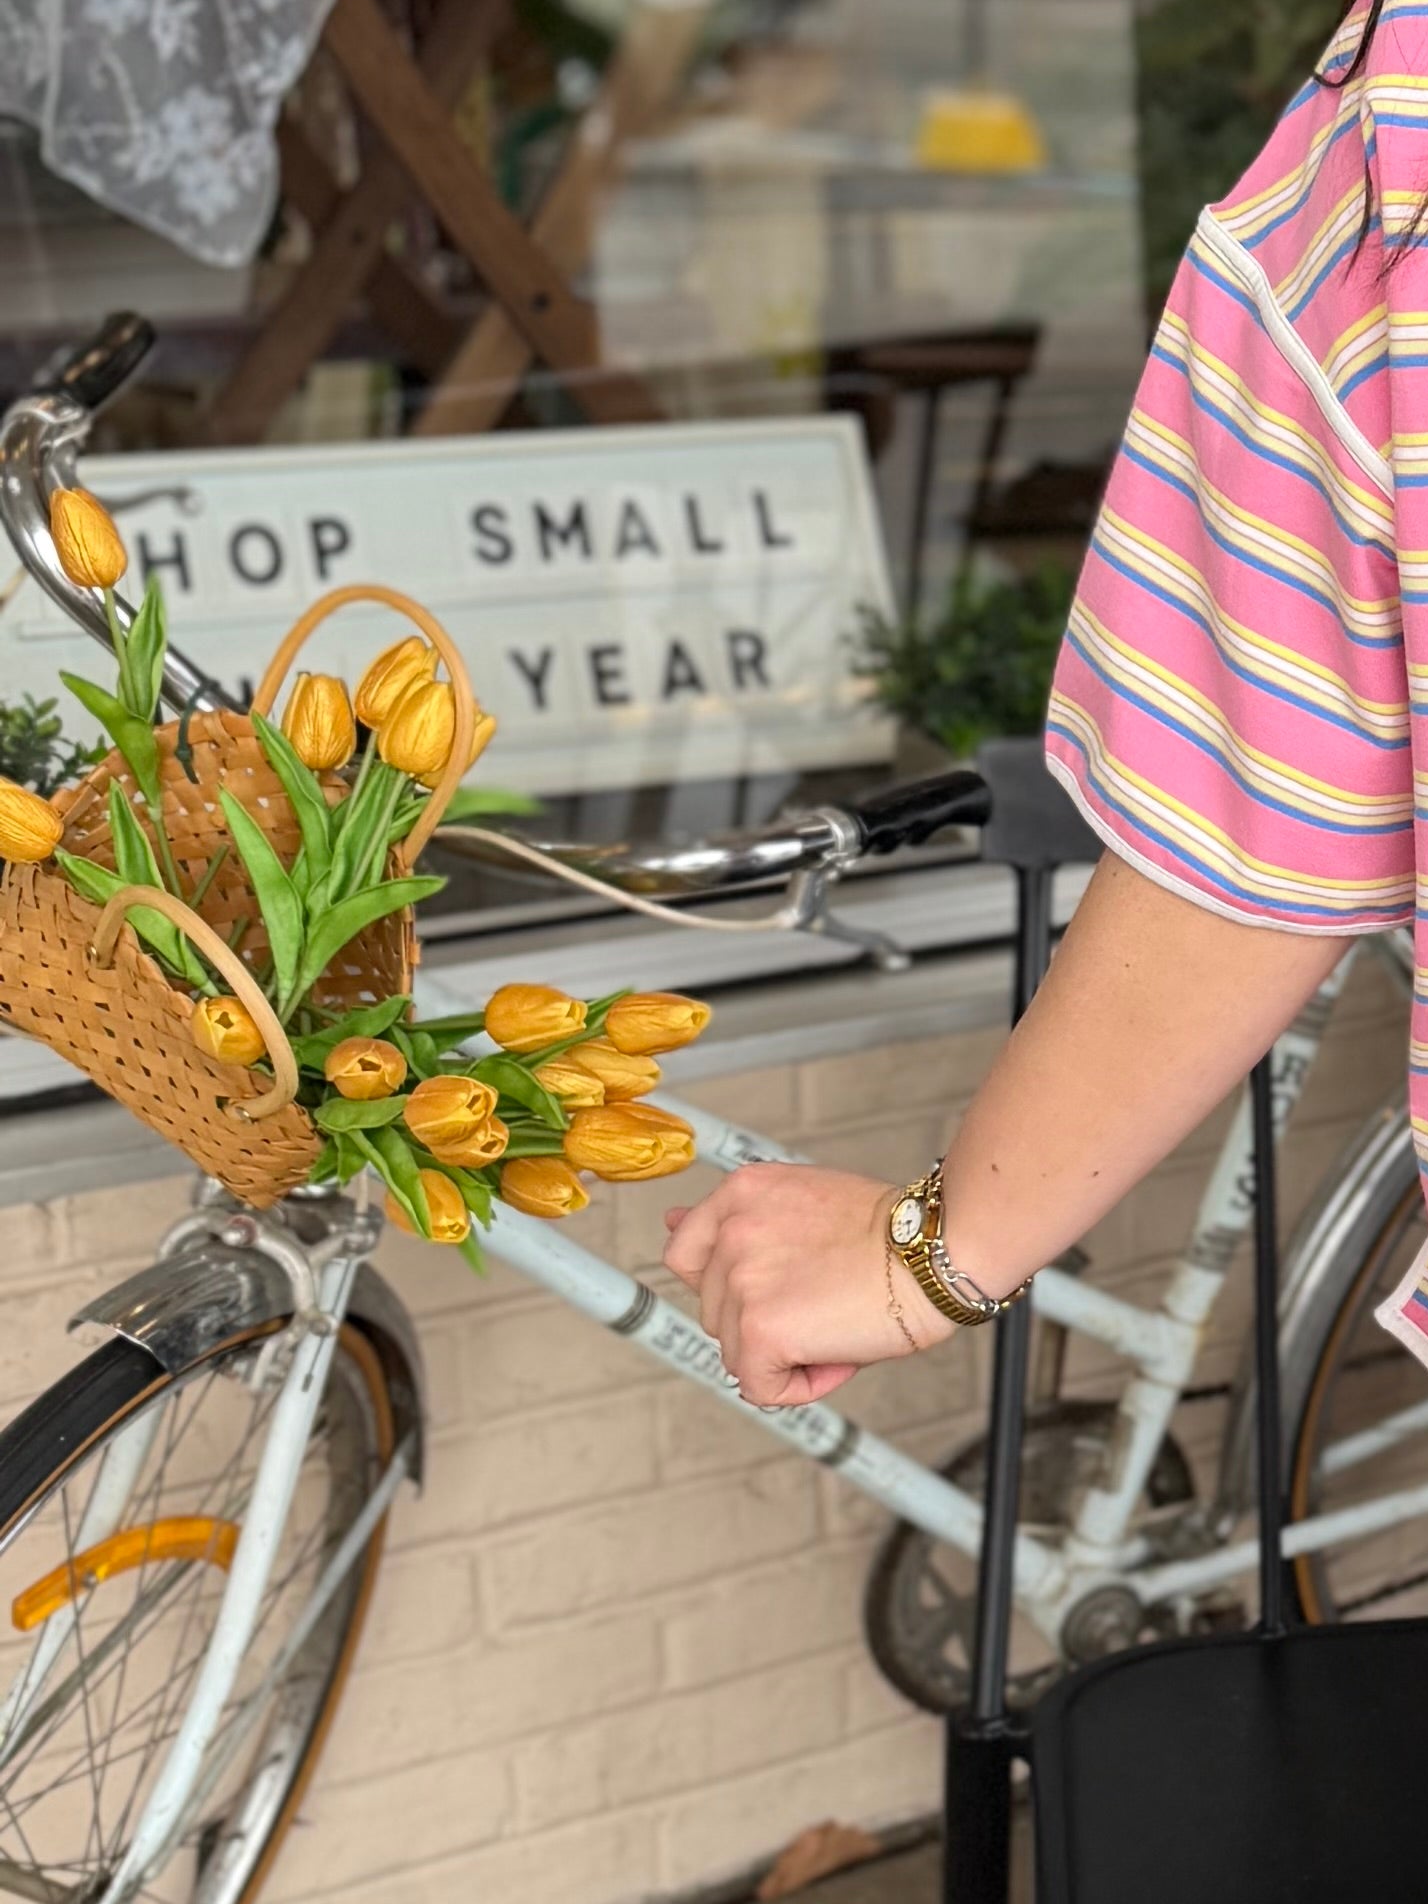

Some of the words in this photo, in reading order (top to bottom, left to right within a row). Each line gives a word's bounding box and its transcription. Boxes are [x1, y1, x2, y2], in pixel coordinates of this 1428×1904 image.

[134, 515, 352, 591] HOP
[470, 488, 794, 566] SMALL
[508, 629, 771, 710] YEAR
